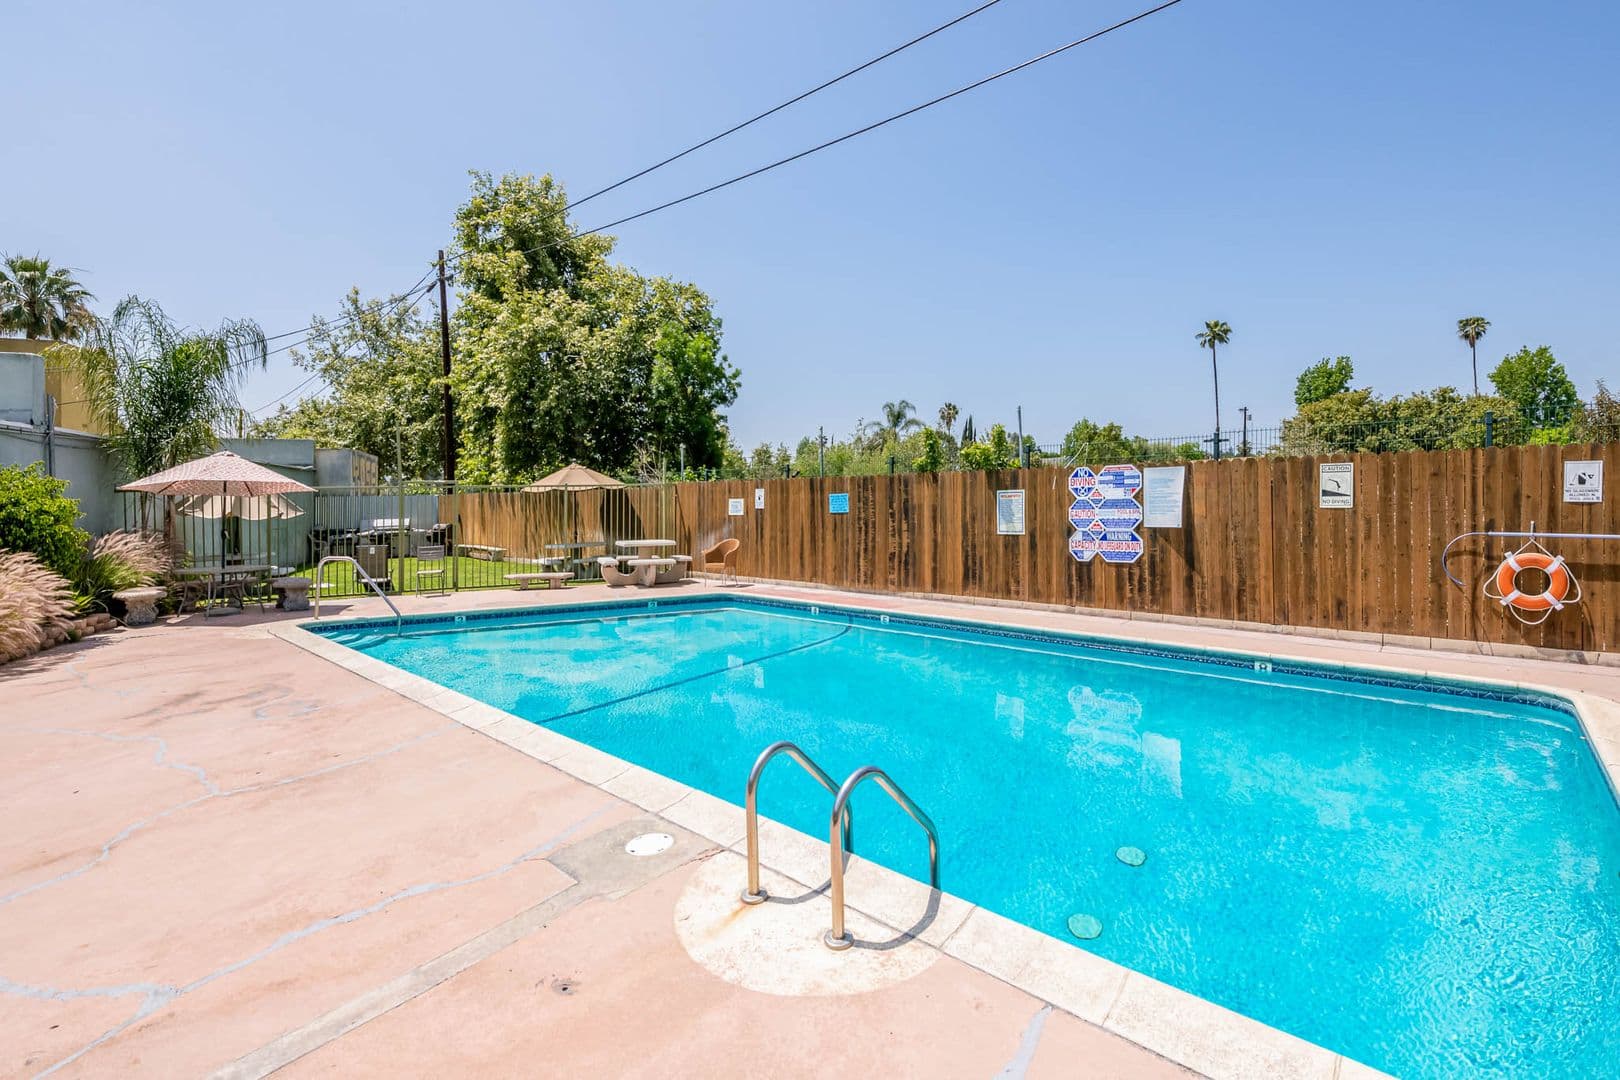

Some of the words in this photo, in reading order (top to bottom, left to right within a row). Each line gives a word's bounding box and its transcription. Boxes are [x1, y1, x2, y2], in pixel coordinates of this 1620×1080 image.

[1078, 467, 1089, 477] NO
[1070, 477, 1096, 487] DIVING
[1070, 509, 1096, 518] CAUTION
[1106, 531, 1132, 541] WARNING
[1071, 541, 1096, 550] CAPACITY
